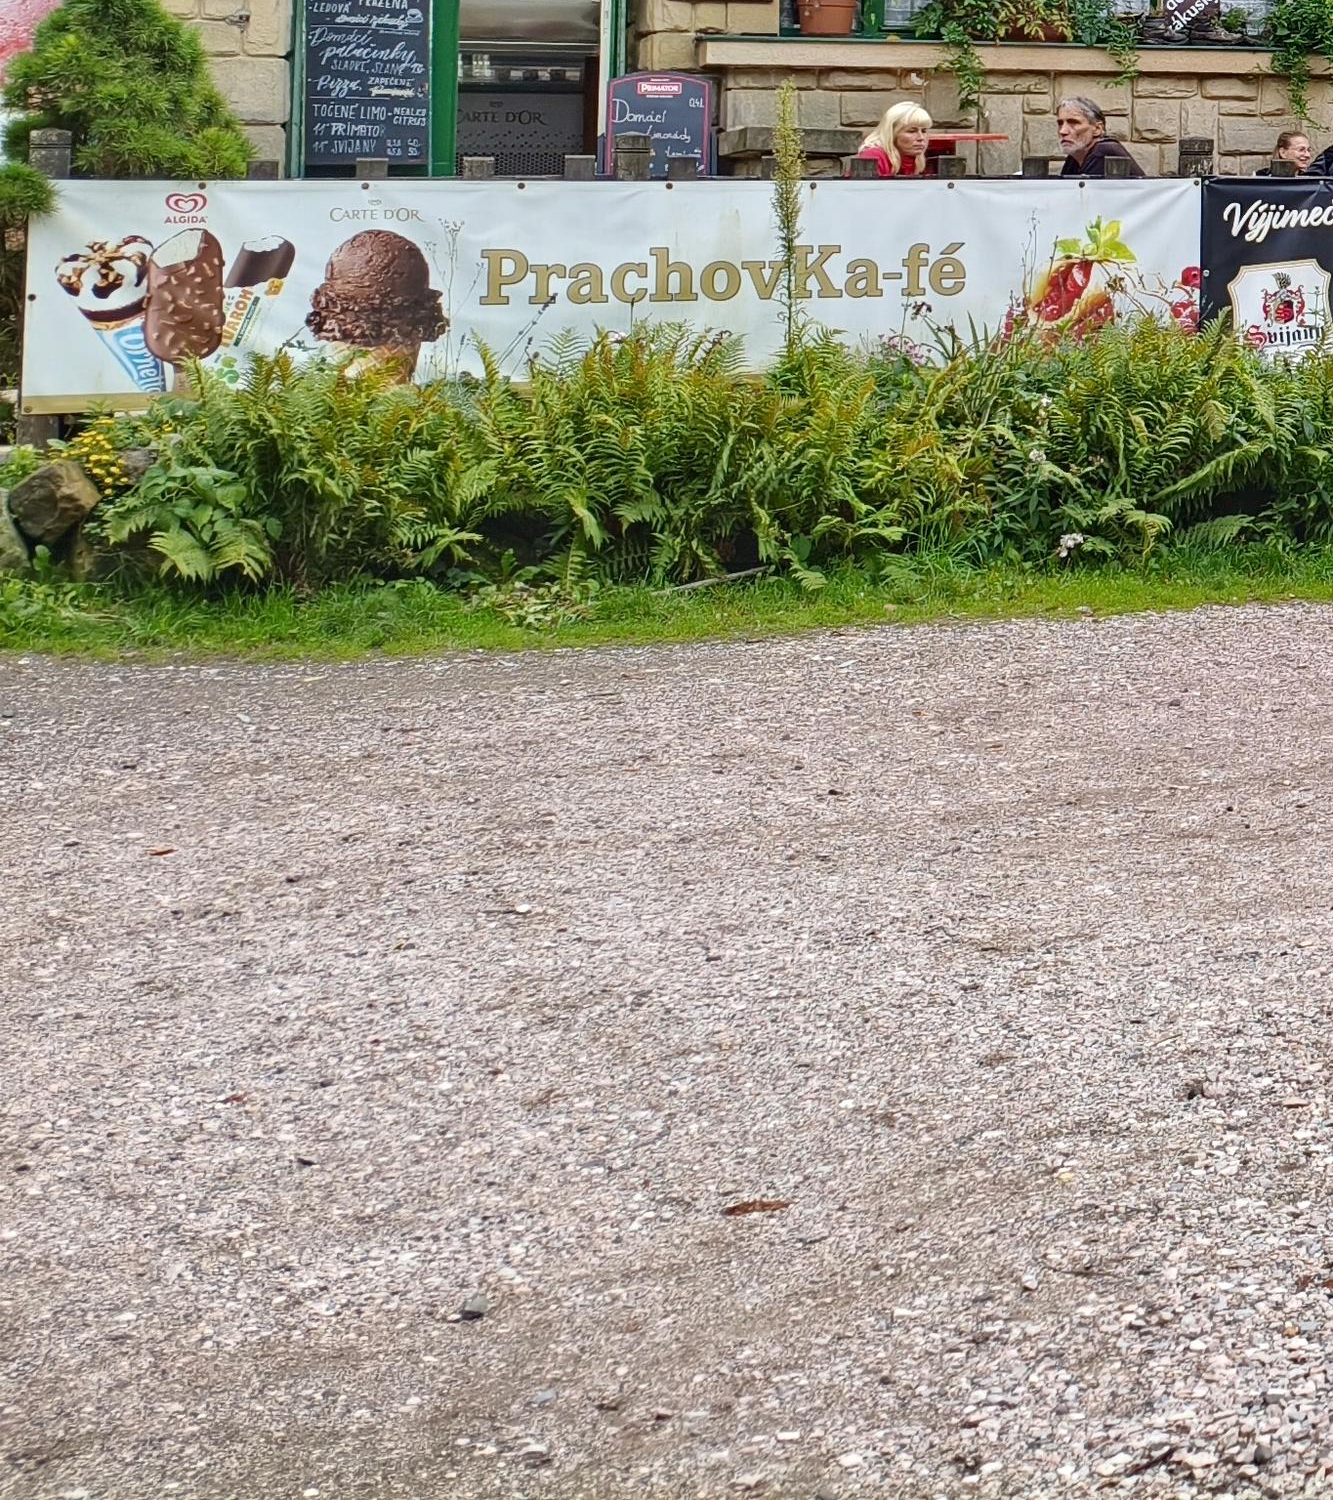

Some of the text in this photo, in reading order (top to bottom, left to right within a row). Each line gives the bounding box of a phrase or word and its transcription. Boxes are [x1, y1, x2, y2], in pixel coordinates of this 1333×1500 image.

[641, 83, 679, 92] PRIMATOR
[457, 109, 500, 124] ARTE
[611, 98, 667, 123] Domácí
[164, 216, 207, 224] ALGIDA
[330, 207, 426, 222] CARTE D'OR
[480, 243, 967, 305] PrachovKa-fé
